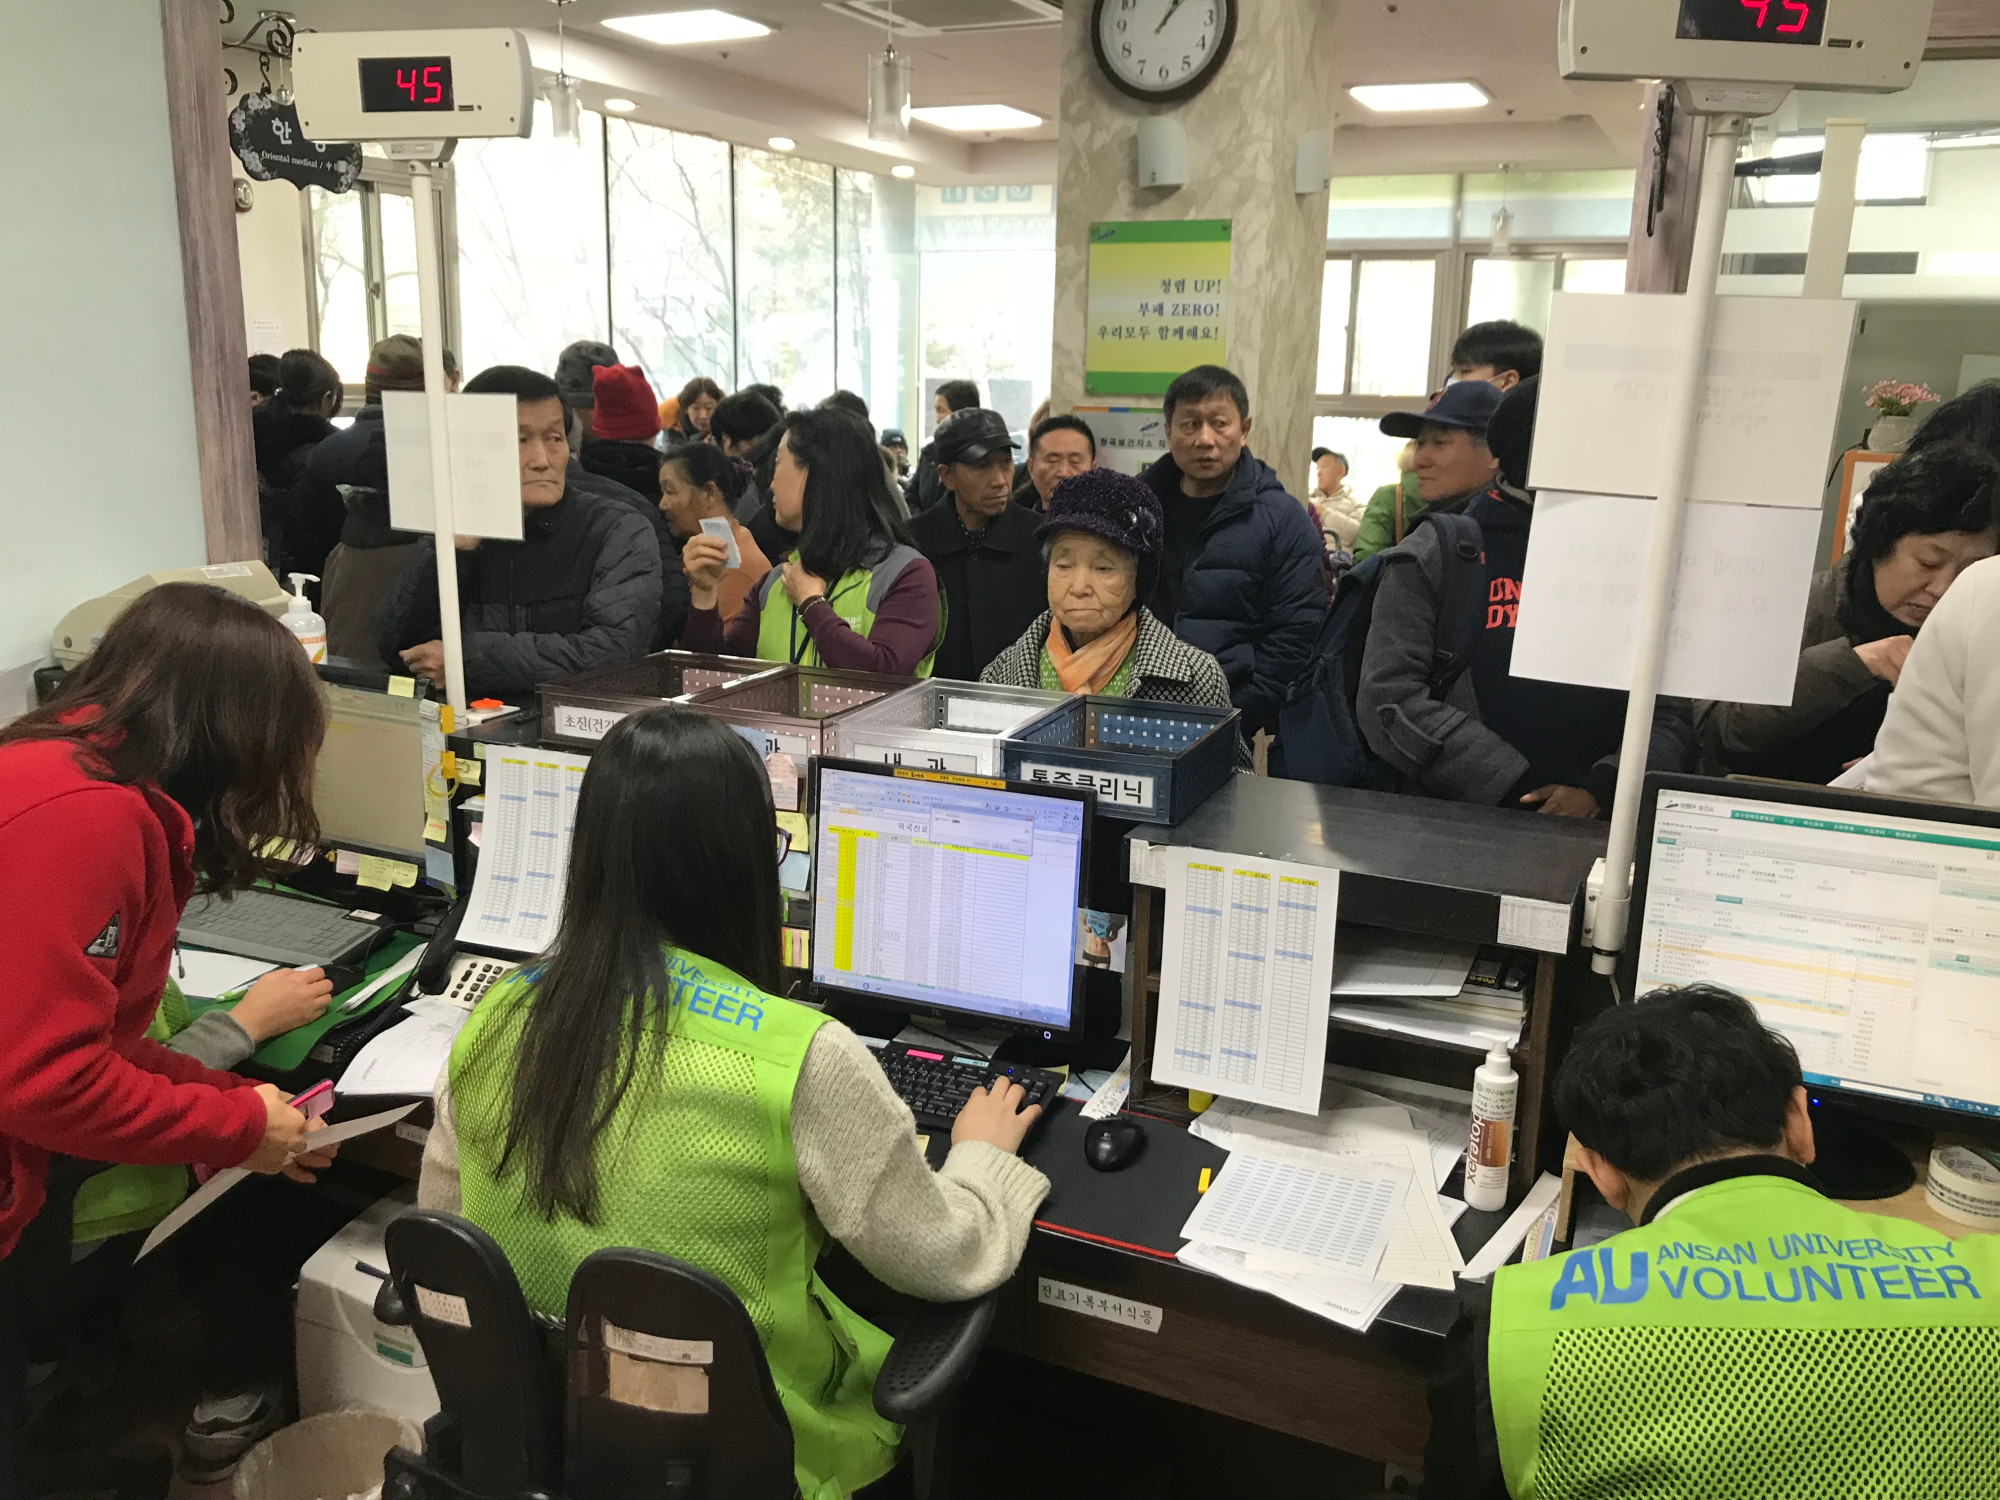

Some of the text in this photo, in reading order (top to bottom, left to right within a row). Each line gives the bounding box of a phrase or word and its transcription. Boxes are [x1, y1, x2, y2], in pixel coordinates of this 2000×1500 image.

[1203, 9, 1214, 27] 3
[1739, 0, 1808, 32] 45
[1117, 19, 1127, 33] 9
[1121, 42, 1132, 58] 8
[1195, 34, 1206, 50] 4
[1137, 59, 1147, 76] 7
[1158, 64, 1169, 79] 6
[1181, 55, 1191, 72] 5
[396, 66, 442, 103] 45
[261, 150, 290, 163] Oriental
[291, 158, 318, 168] medical
[1160, 278, 1221, 294] 청렴 UP!
[1138, 302, 1220, 317] 부패 ZERO!
[1097, 325, 1219, 340] 우리모두 함께해요!
[1656, 1233, 1955, 1265] ANSAN UNIVERSITY
[1549, 1247, 1649, 1310] AU
[1657, 1261, 1982, 1303] VOLUNTEER
